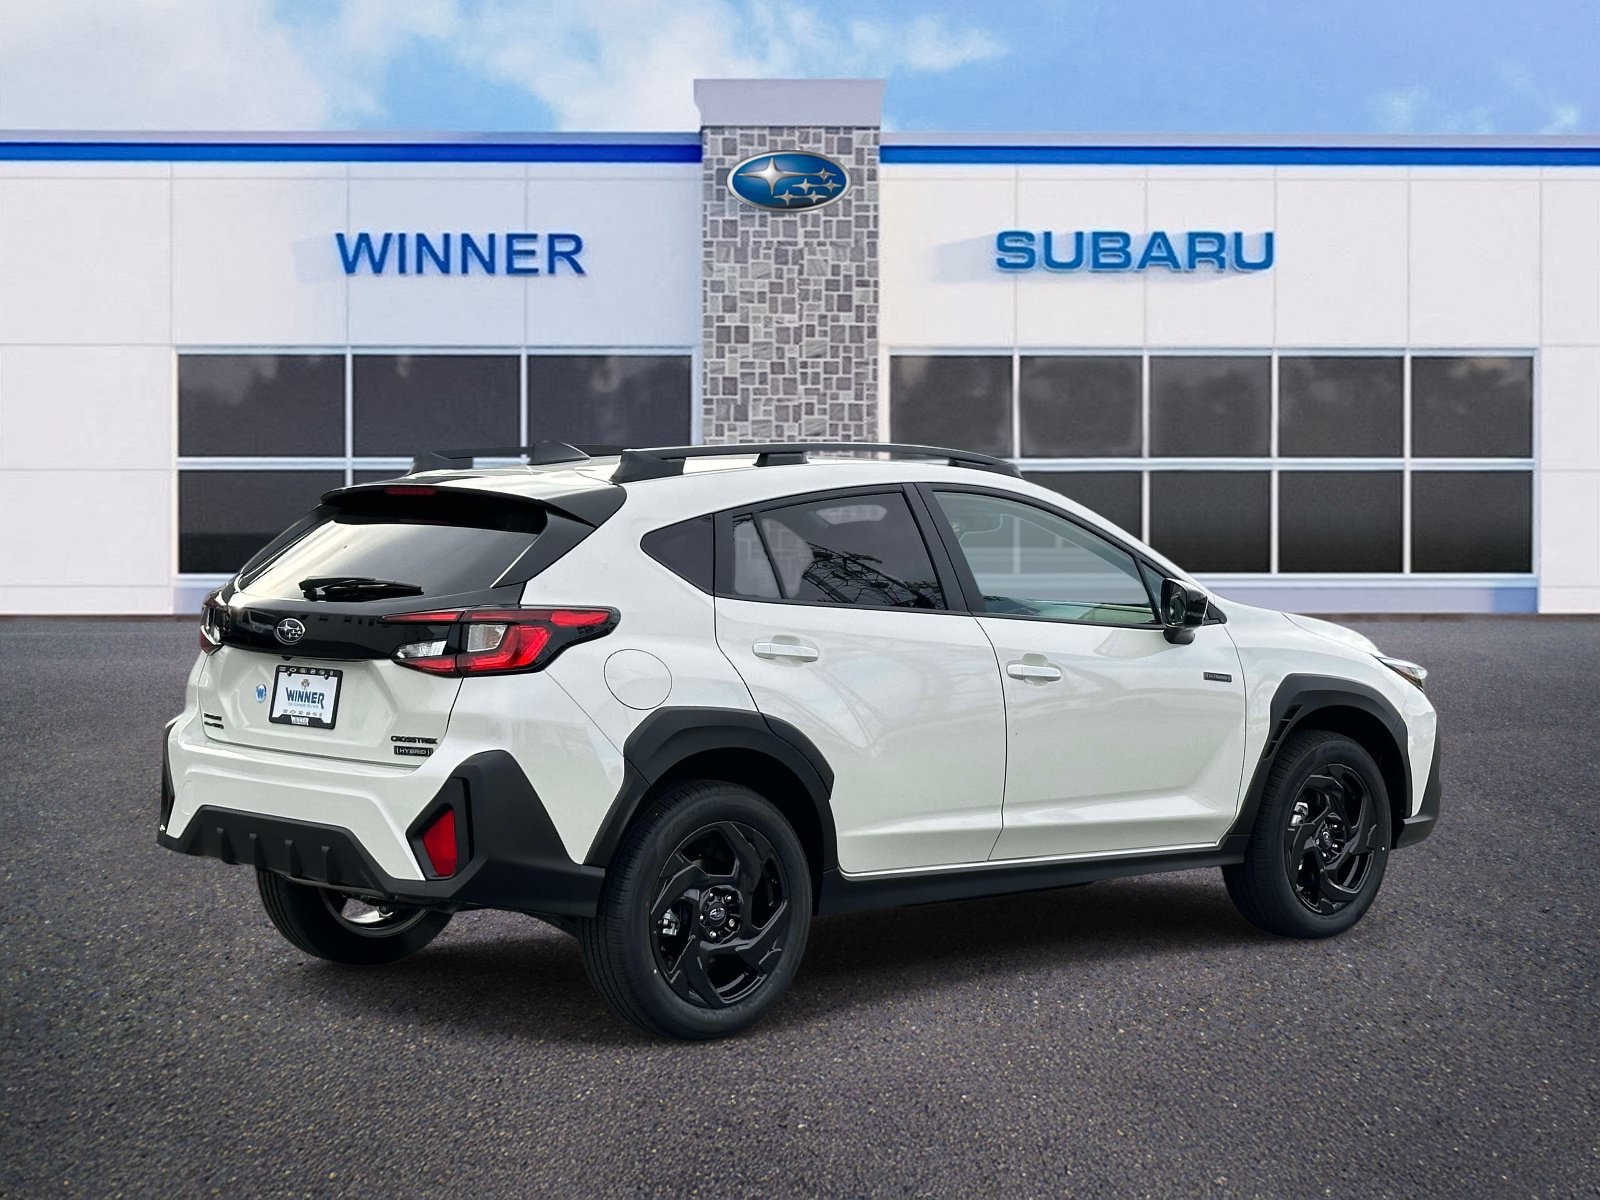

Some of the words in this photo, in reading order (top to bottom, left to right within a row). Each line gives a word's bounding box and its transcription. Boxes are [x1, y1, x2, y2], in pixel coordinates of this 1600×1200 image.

[335, 232, 586, 275] WINNER
[995, 230, 1275, 272] SUBARU
[285, 686, 325, 709] WINNER
[390, 735, 438, 745] CROSSTREK
[399, 747, 428, 756] HYBRID
